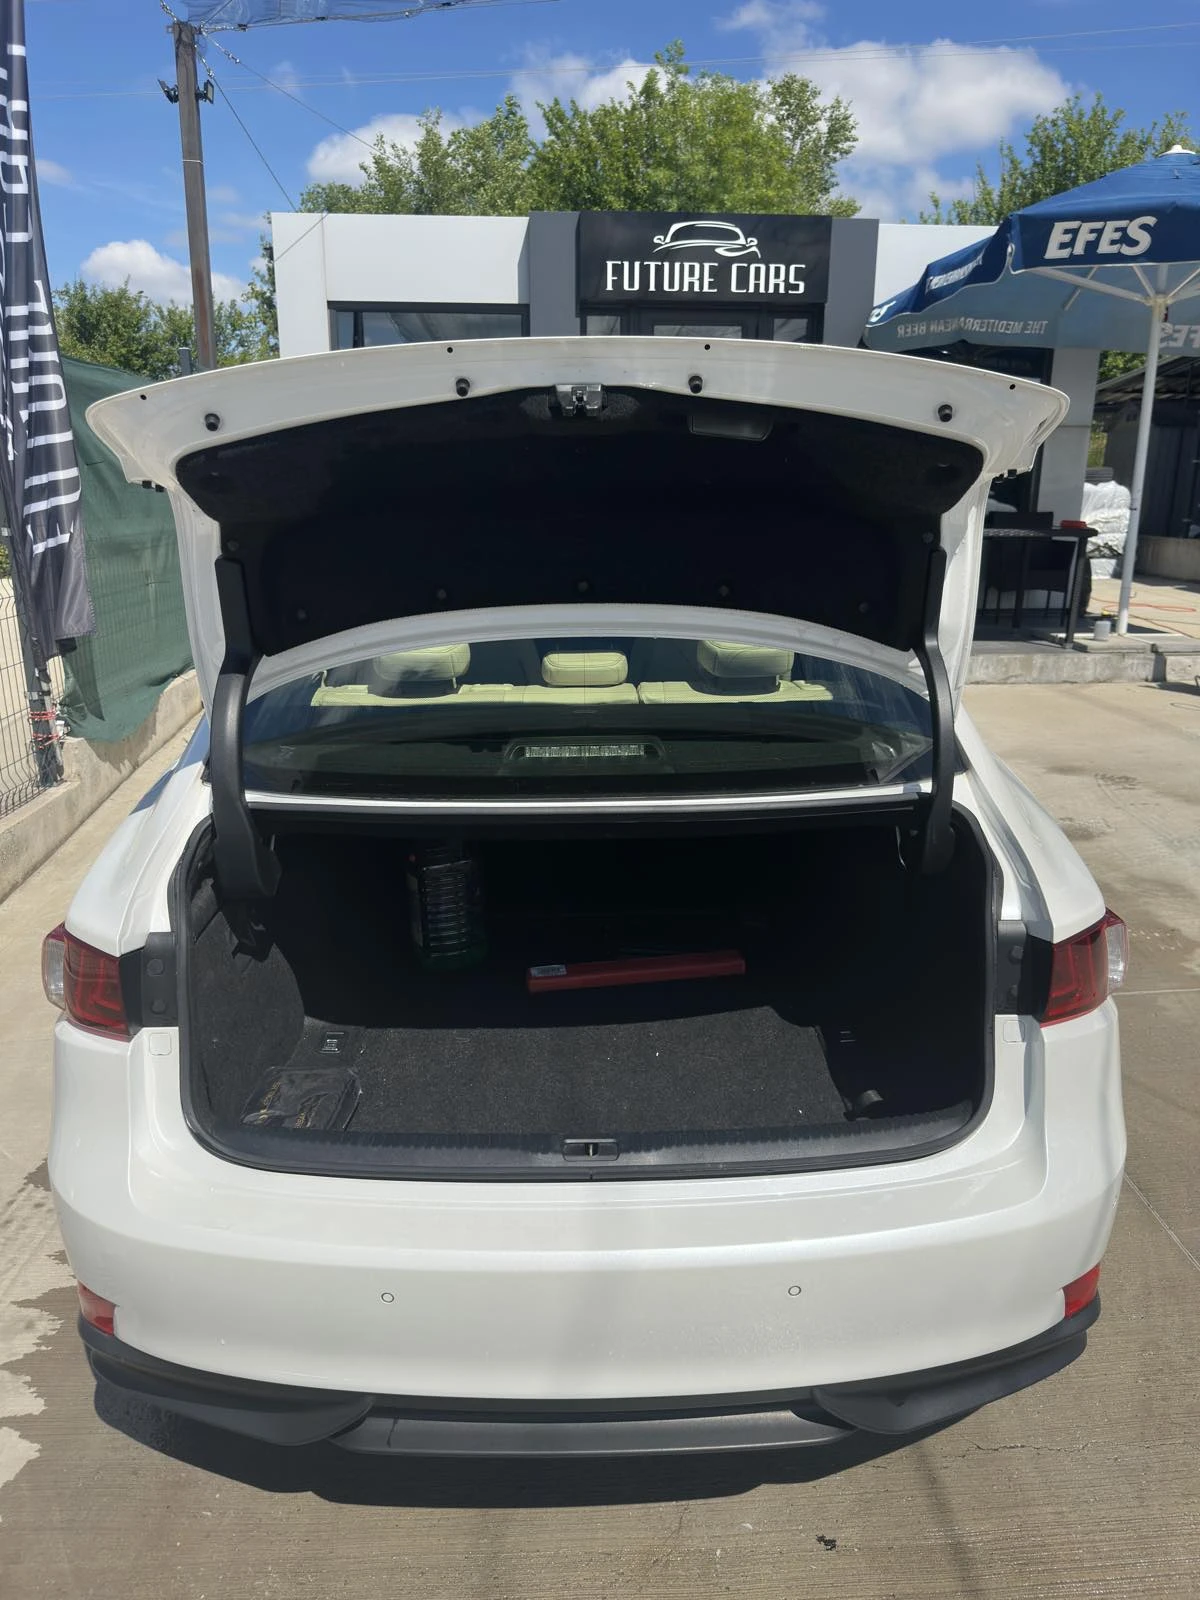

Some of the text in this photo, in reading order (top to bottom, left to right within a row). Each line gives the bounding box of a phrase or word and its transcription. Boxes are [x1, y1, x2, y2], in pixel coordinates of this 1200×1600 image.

[1044, 216, 1158, 259] EFES
[605, 261, 806, 294] FUTURE CARS
